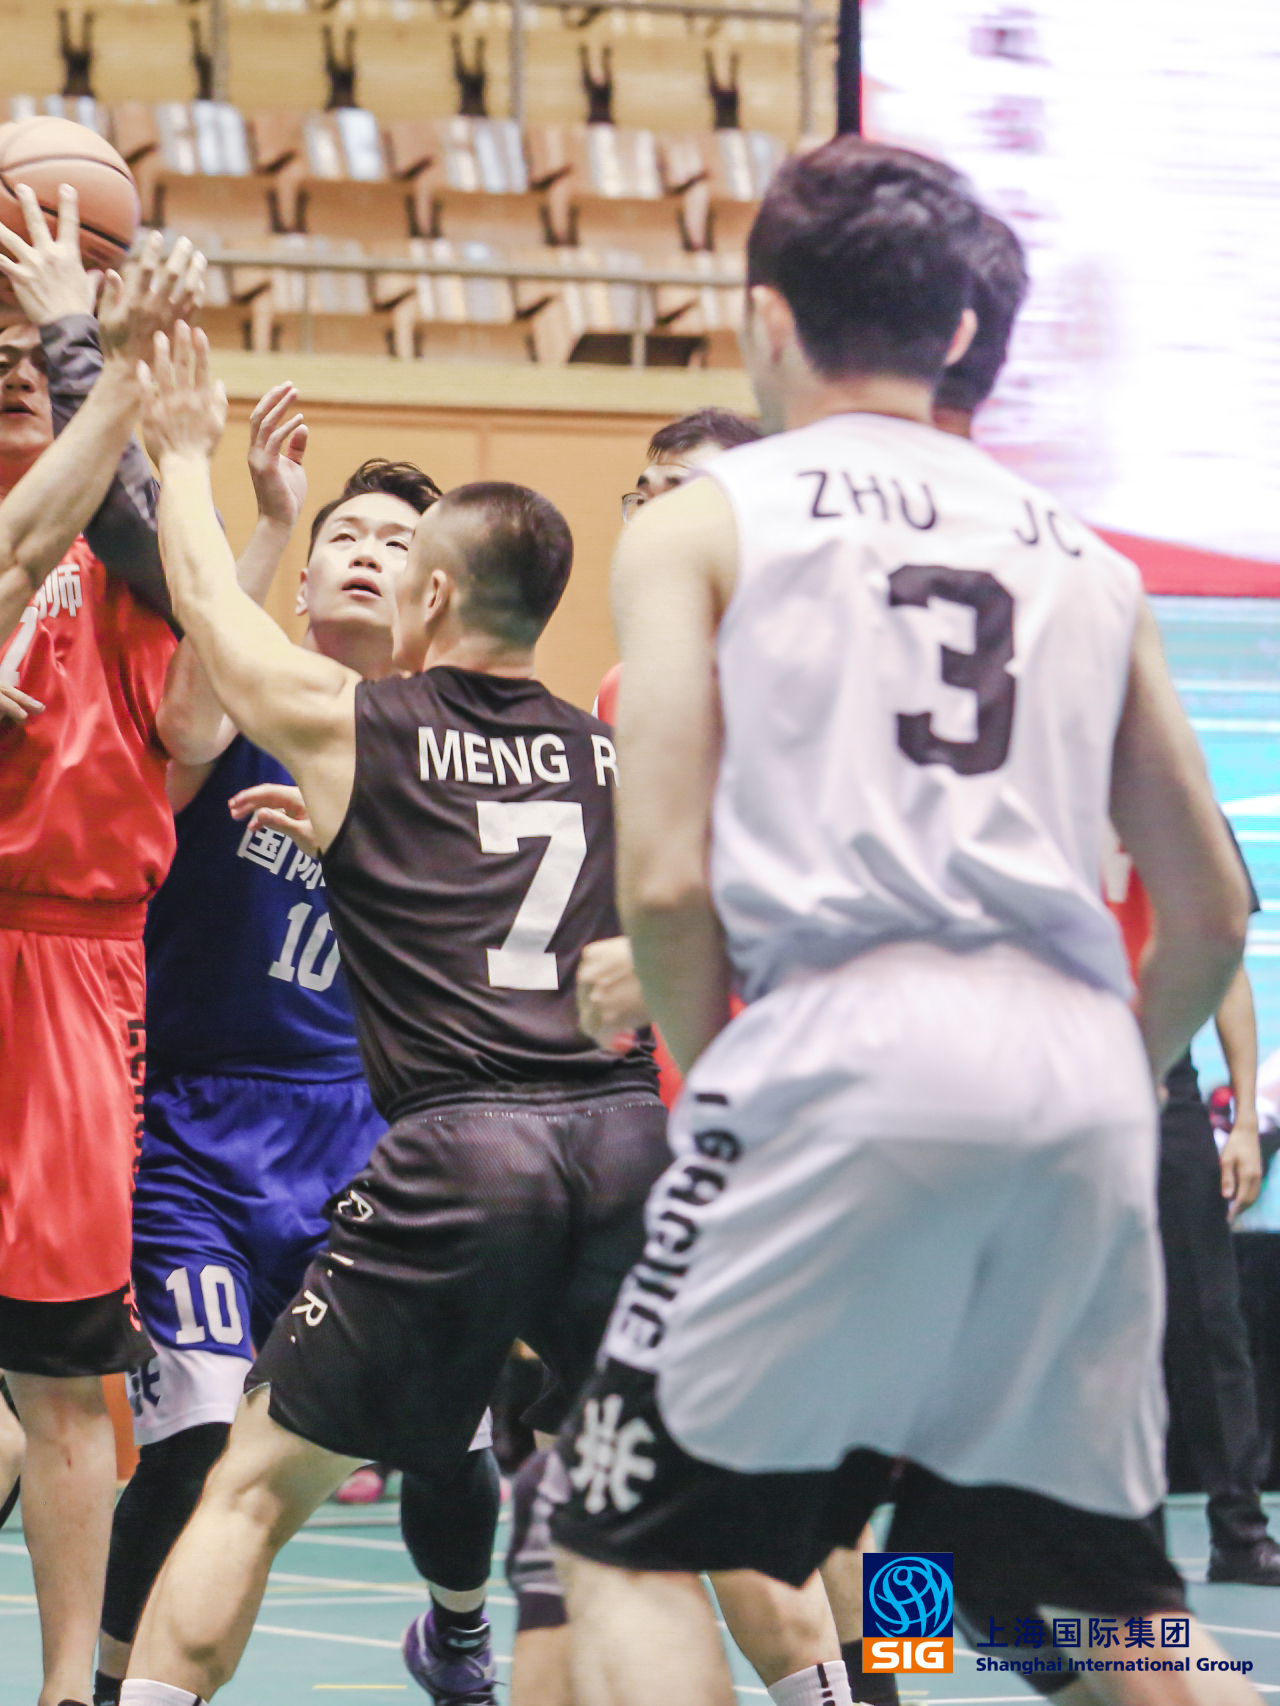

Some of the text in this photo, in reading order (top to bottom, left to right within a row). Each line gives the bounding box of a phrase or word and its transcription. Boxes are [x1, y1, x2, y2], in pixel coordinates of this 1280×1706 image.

[797, 470, 938, 530] ZHU
[887, 564, 1016, 777] 3
[418, 726, 571, 786] MENG
[476, 800, 588, 991] 7
[268, 902, 341, 992] 10
[165, 1264, 244, 1346] 10
